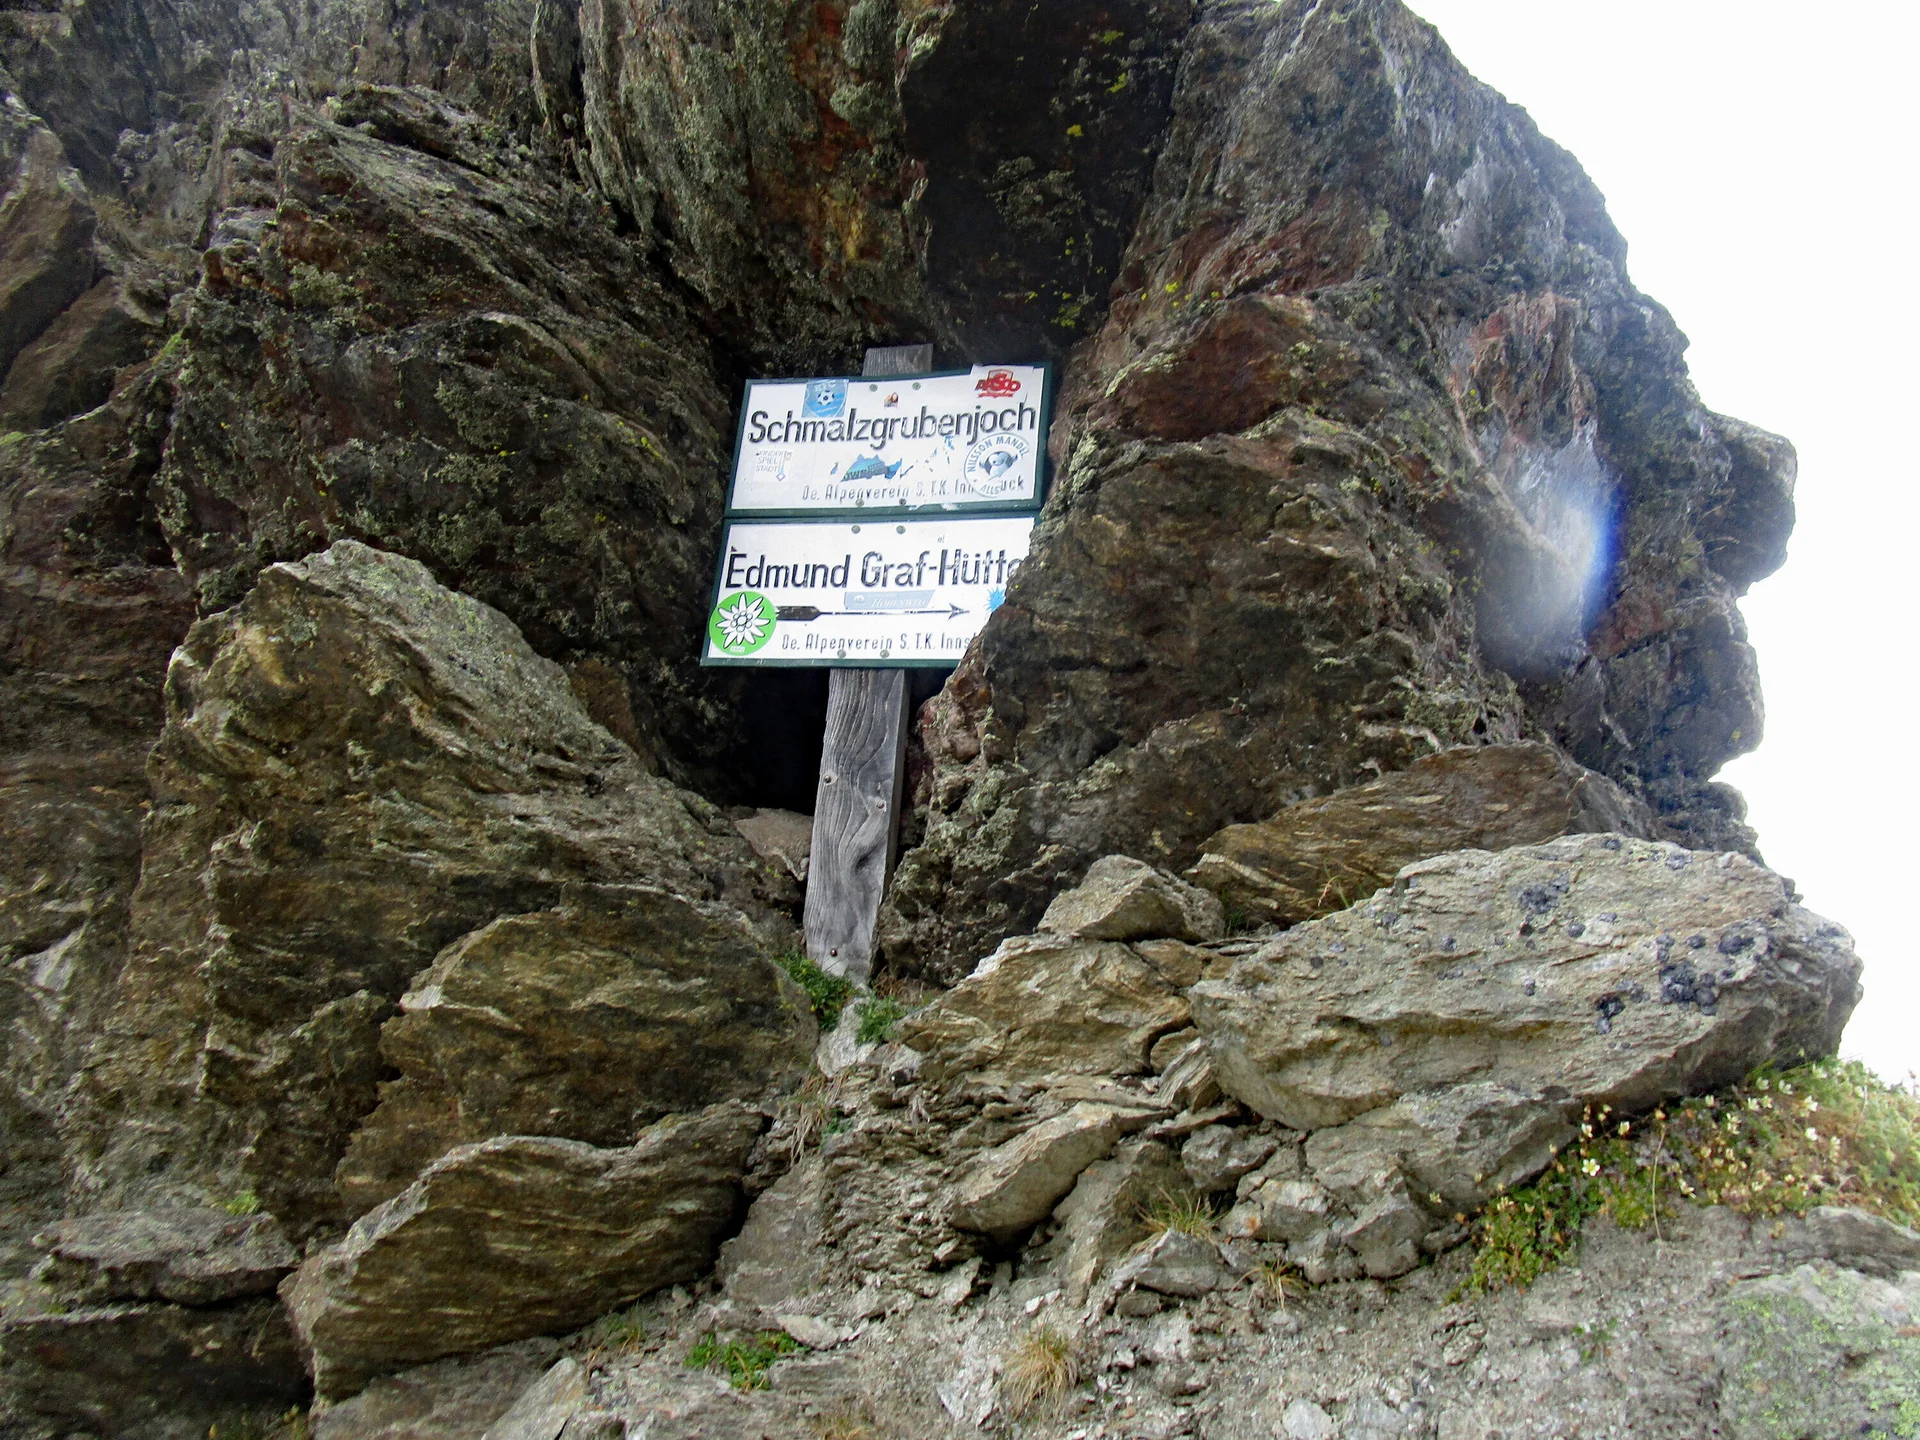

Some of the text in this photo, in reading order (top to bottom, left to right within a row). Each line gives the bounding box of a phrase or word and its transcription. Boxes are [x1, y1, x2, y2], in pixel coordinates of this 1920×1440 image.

[748, 402, 1036, 449] Schmalzgrubenjoch
[757, 457, 778, 465] SPIEL
[967, 439, 992, 473] NILSSON
[825, 483, 909, 503] Alpenverein
[725, 553, 851, 589] Edmund
[805, 633, 893, 653] Alpenverein
